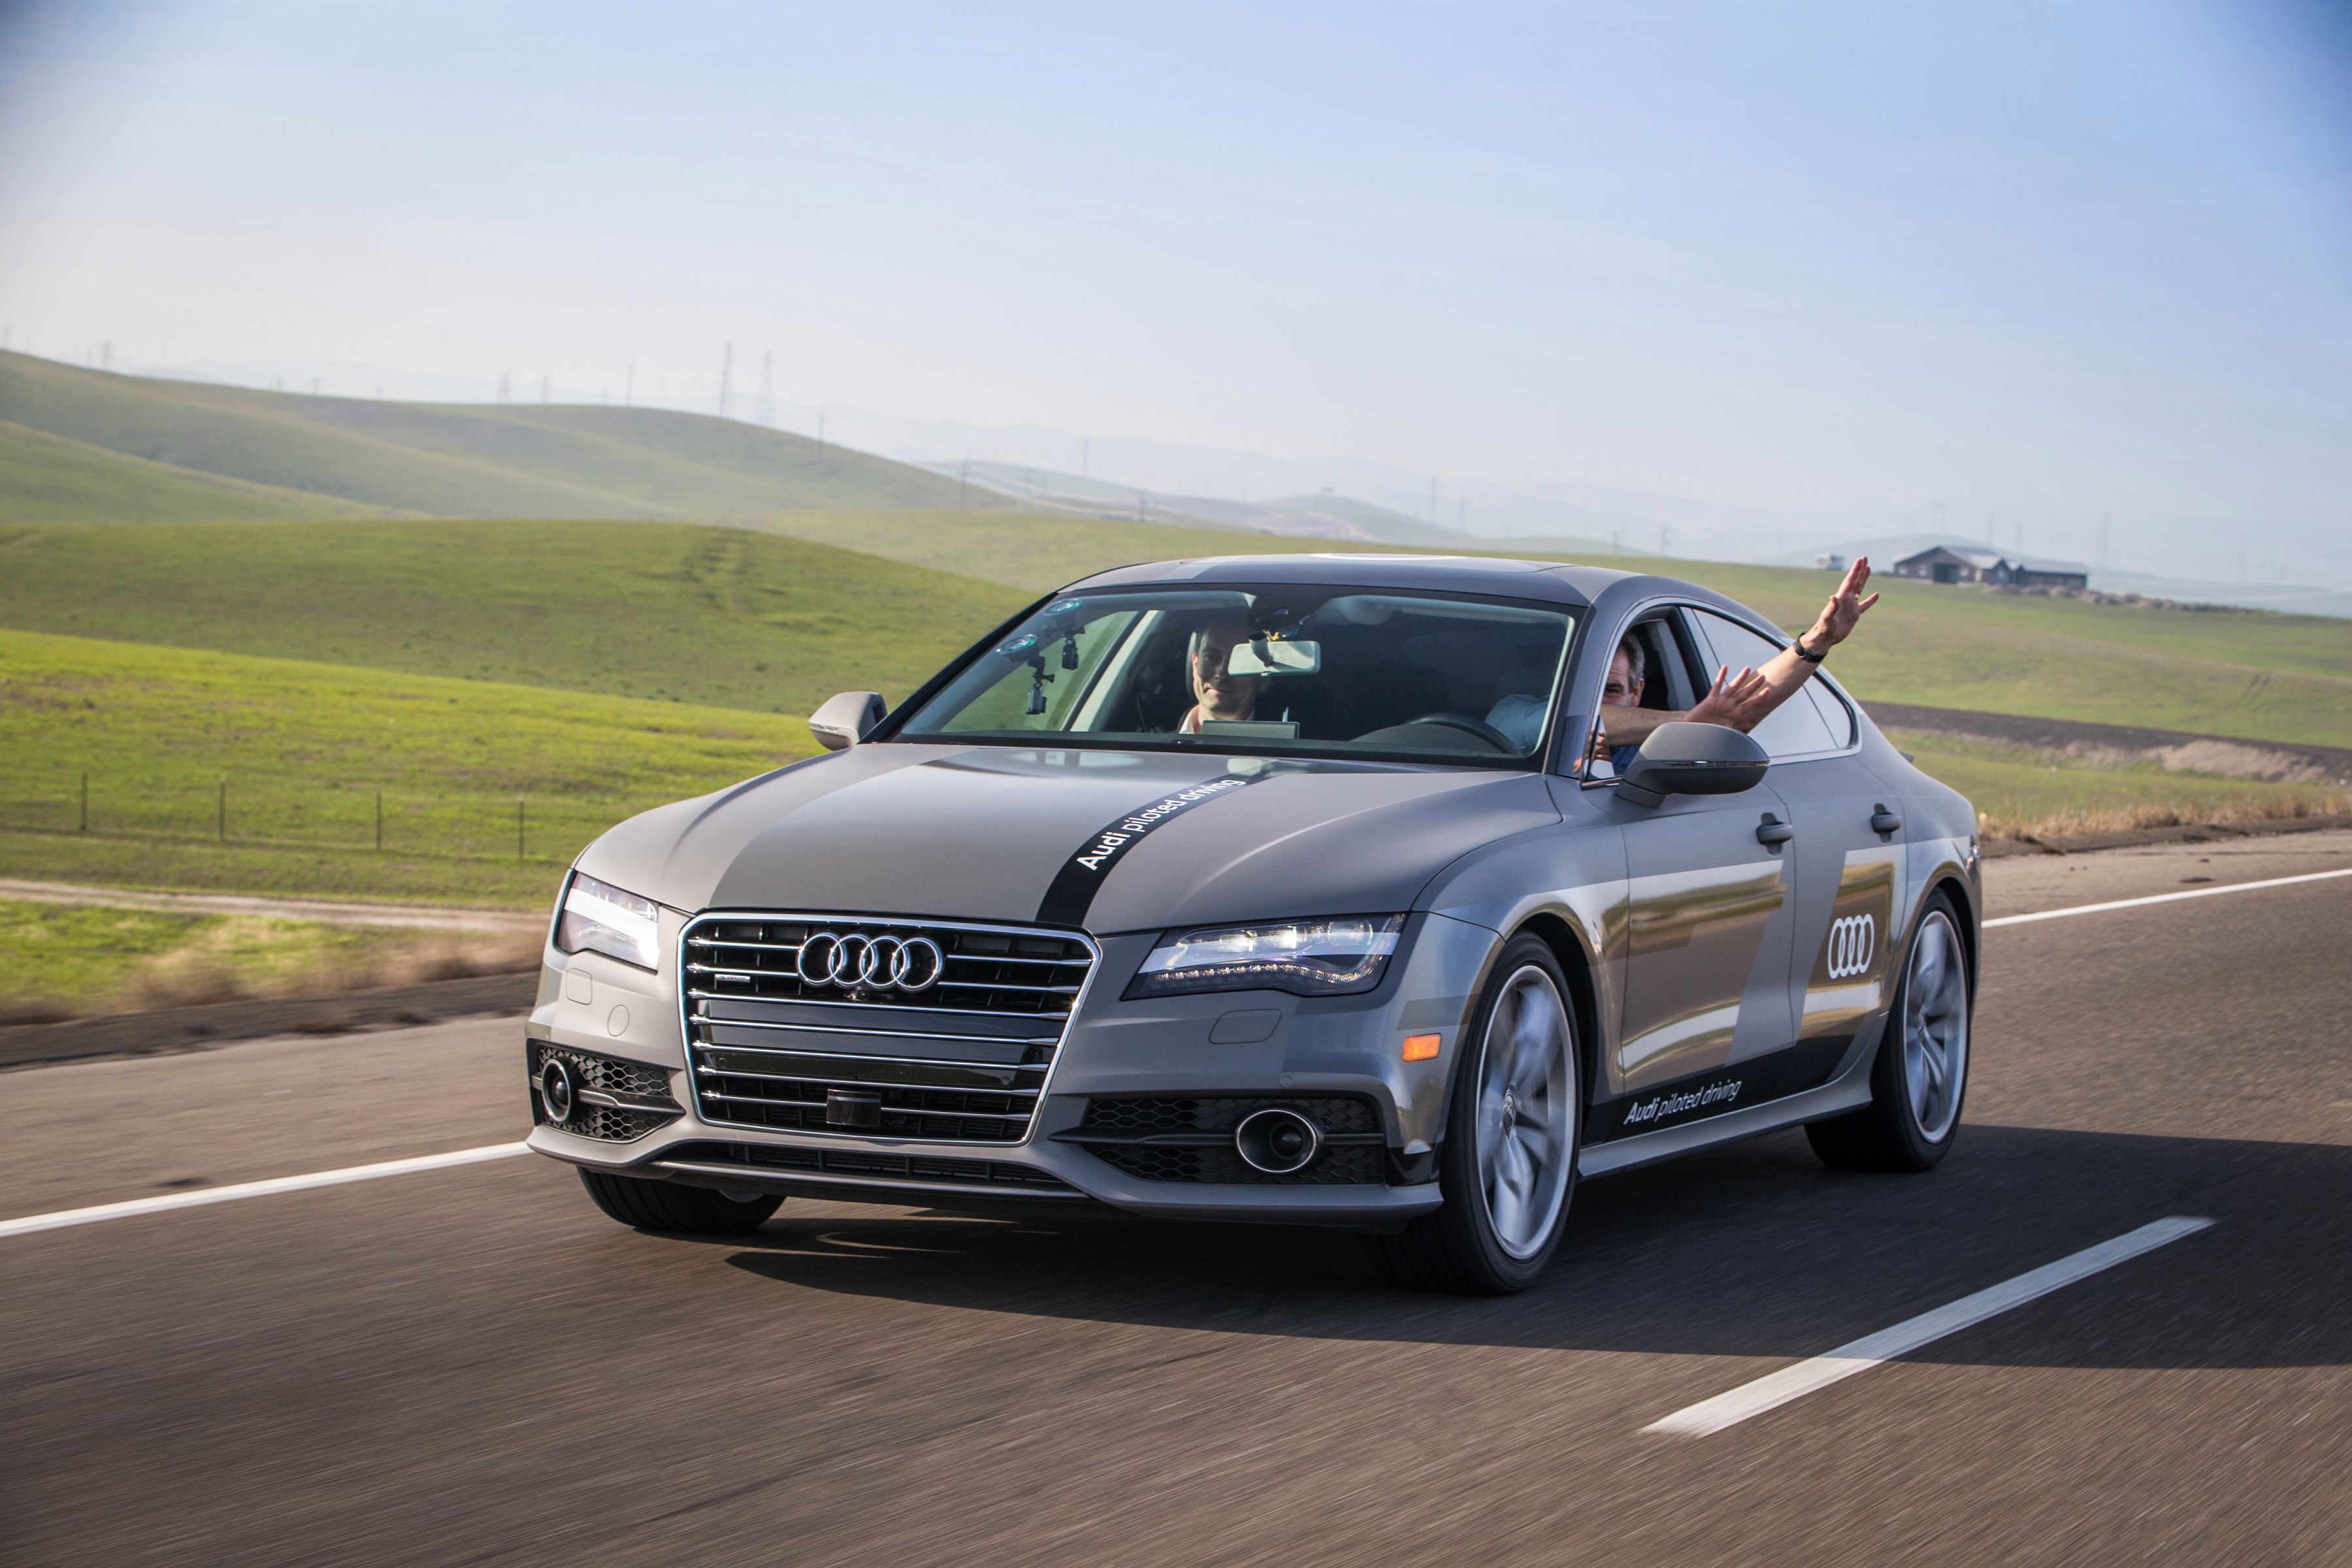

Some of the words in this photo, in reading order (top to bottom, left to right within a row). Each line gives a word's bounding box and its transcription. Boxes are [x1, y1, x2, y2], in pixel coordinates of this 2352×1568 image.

[1076, 832, 1131, 871] Audi
[1120, 799, 1188, 832] piloted
[1177, 779, 1247, 800] driving
[1623, 1097, 1660, 1124] Audi
[1654, 1086, 1705, 1122] piloted
[1701, 1079, 1742, 1102] driving
